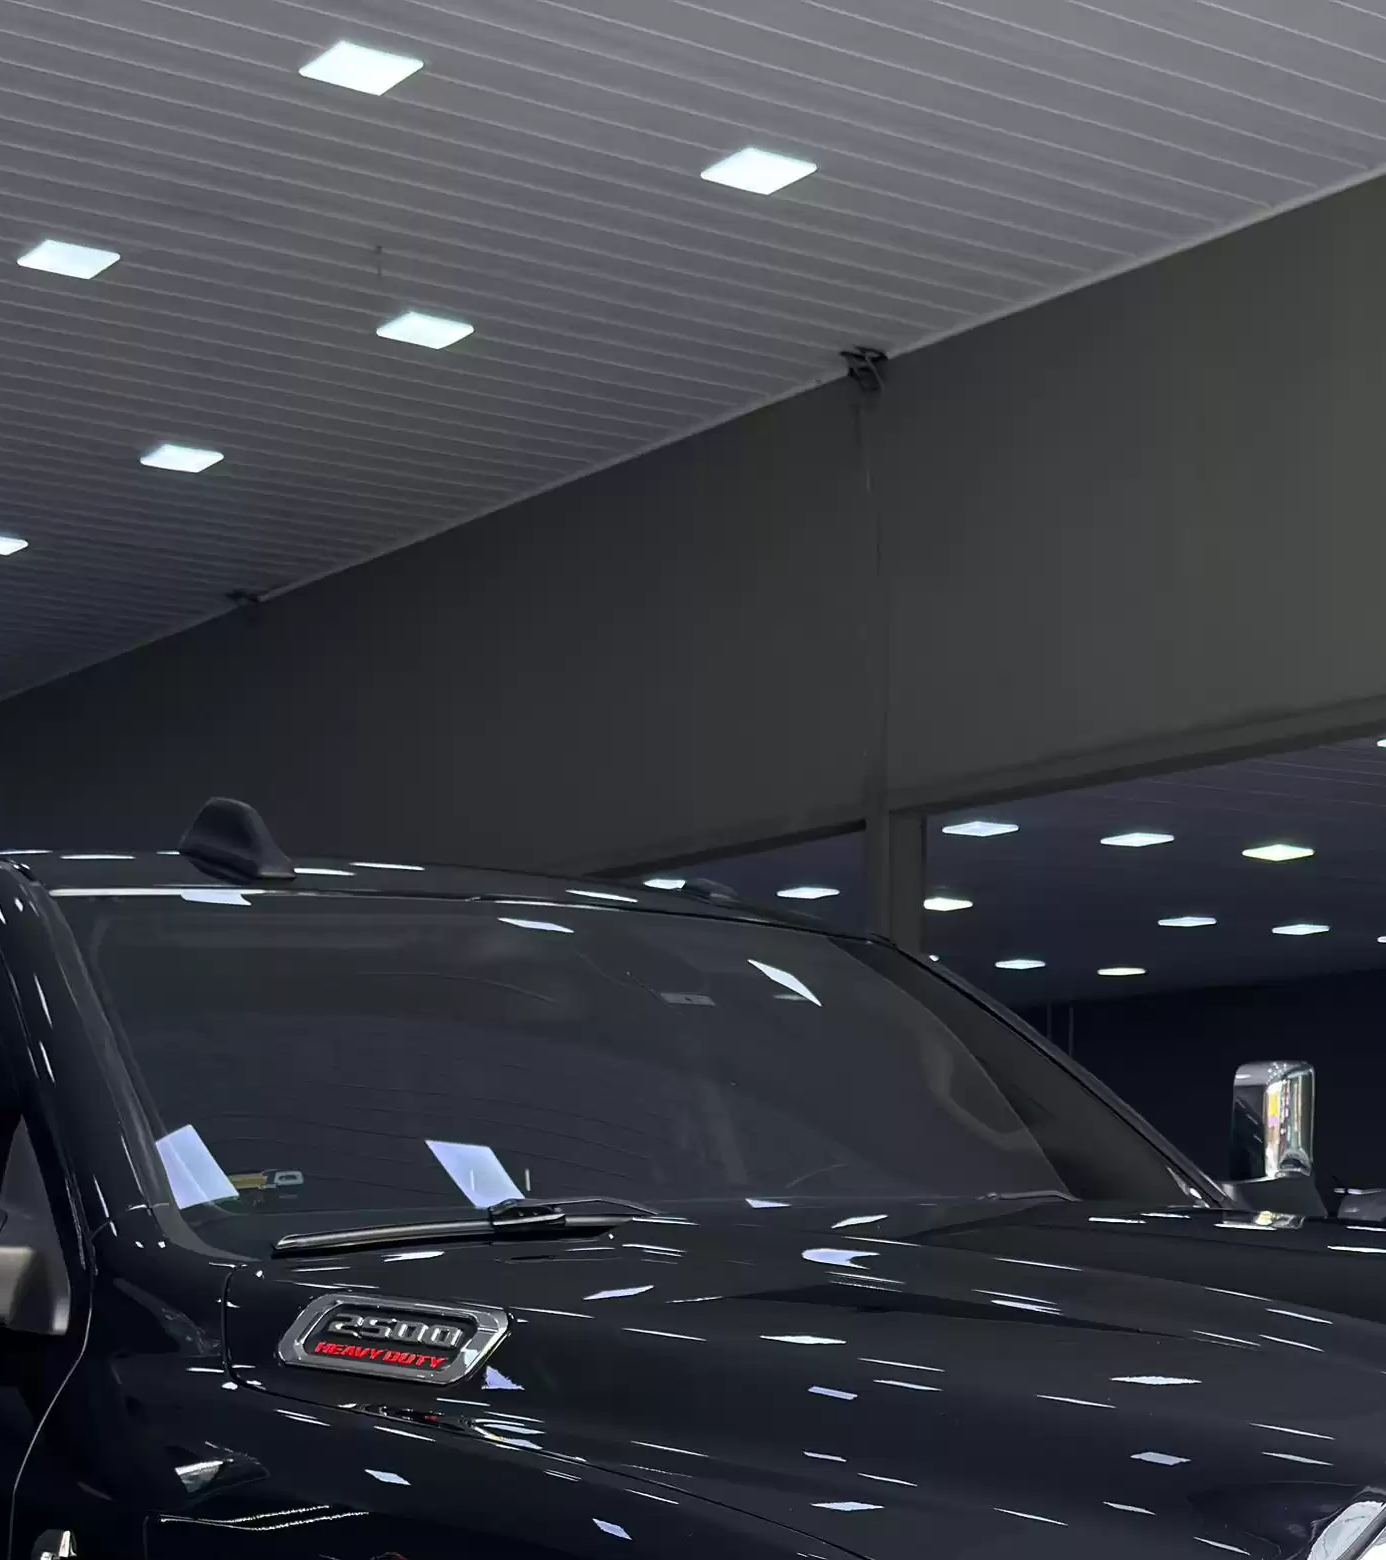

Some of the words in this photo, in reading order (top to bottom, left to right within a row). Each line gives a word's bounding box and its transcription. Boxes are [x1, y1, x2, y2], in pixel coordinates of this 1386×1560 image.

[328, 1313, 463, 1348] 2500
[315, 1342, 380, 1360] HEAVY
[381, 1350, 448, 1369] DUTY
